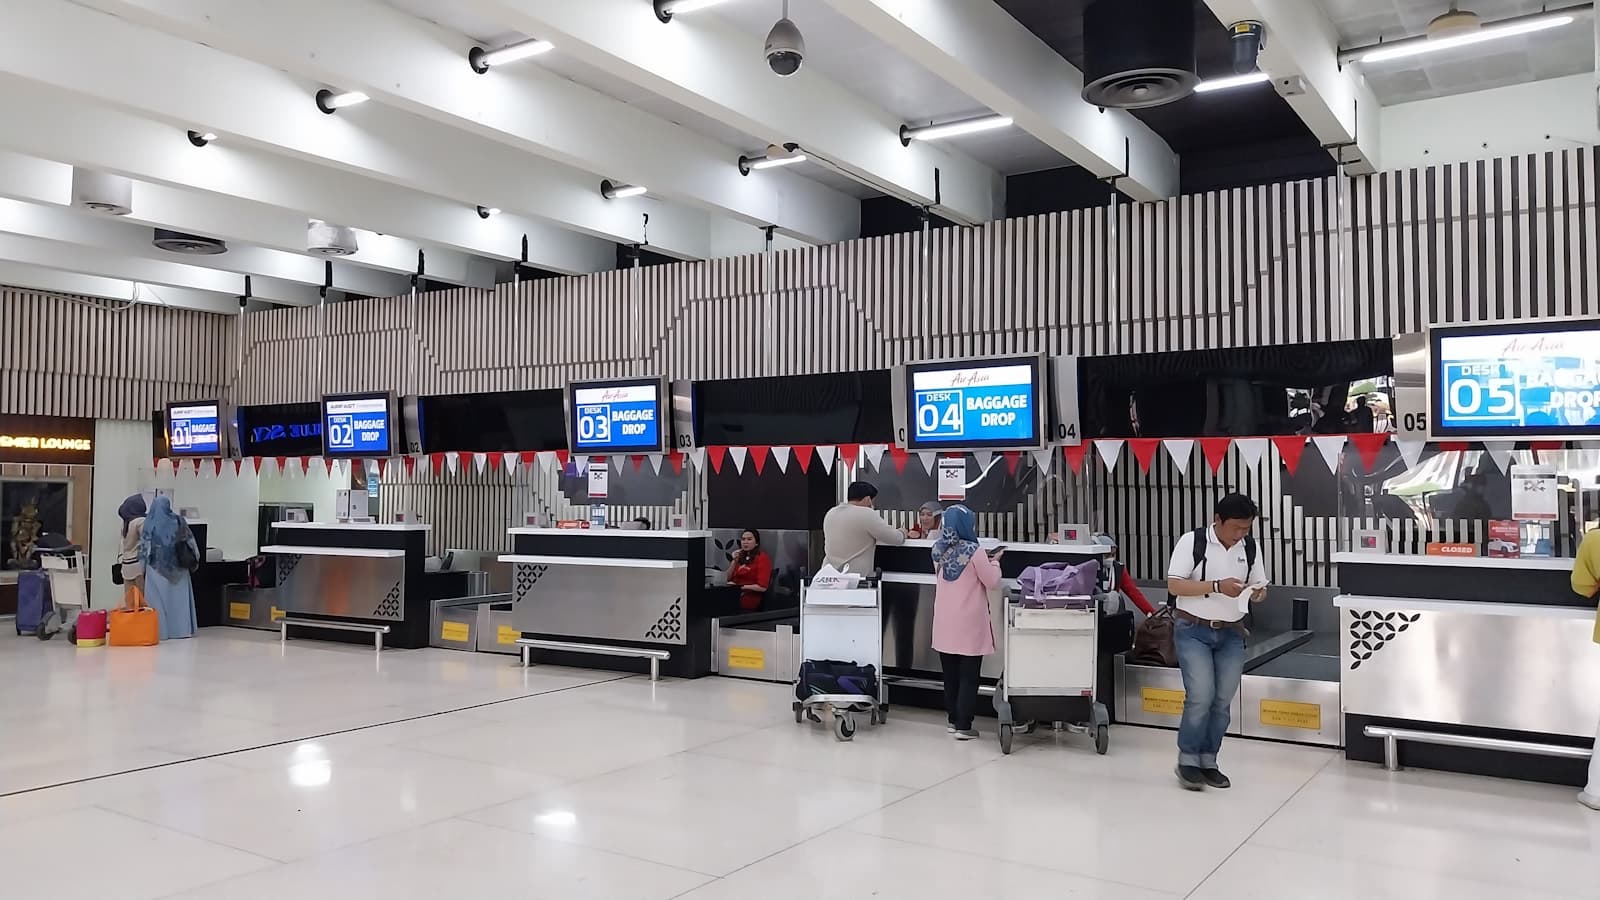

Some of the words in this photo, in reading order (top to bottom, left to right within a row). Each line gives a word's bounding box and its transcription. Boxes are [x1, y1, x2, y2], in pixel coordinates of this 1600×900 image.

[926, 393, 951, 402] DESK
[966, 395, 1028, 411] BAGGAGE
[1450, 378, 1515, 415] 05
[612, 409, 654, 422] BAGGAGE
[919, 404, 961, 432] 04
[981, 412, 1016, 427] DROP
[1404, 412, 1426, 431] 05
[354, 419, 385, 430] BAGGAGE
[580, 415, 608, 439] 03
[622, 423, 647, 435] DROP
[1058, 423, 1076, 439] 04
[174, 426, 190, 446] 01
[331, 424, 352, 445] 02
[361, 431, 380, 442] DROP
[680, 434, 692, 448] 03
[898, 428, 905, 442] 0
[40, 437, 91, 451] LOUNGE
[409, 442, 420, 453] 02
[1441, 546, 1473, 554] CLOSED
